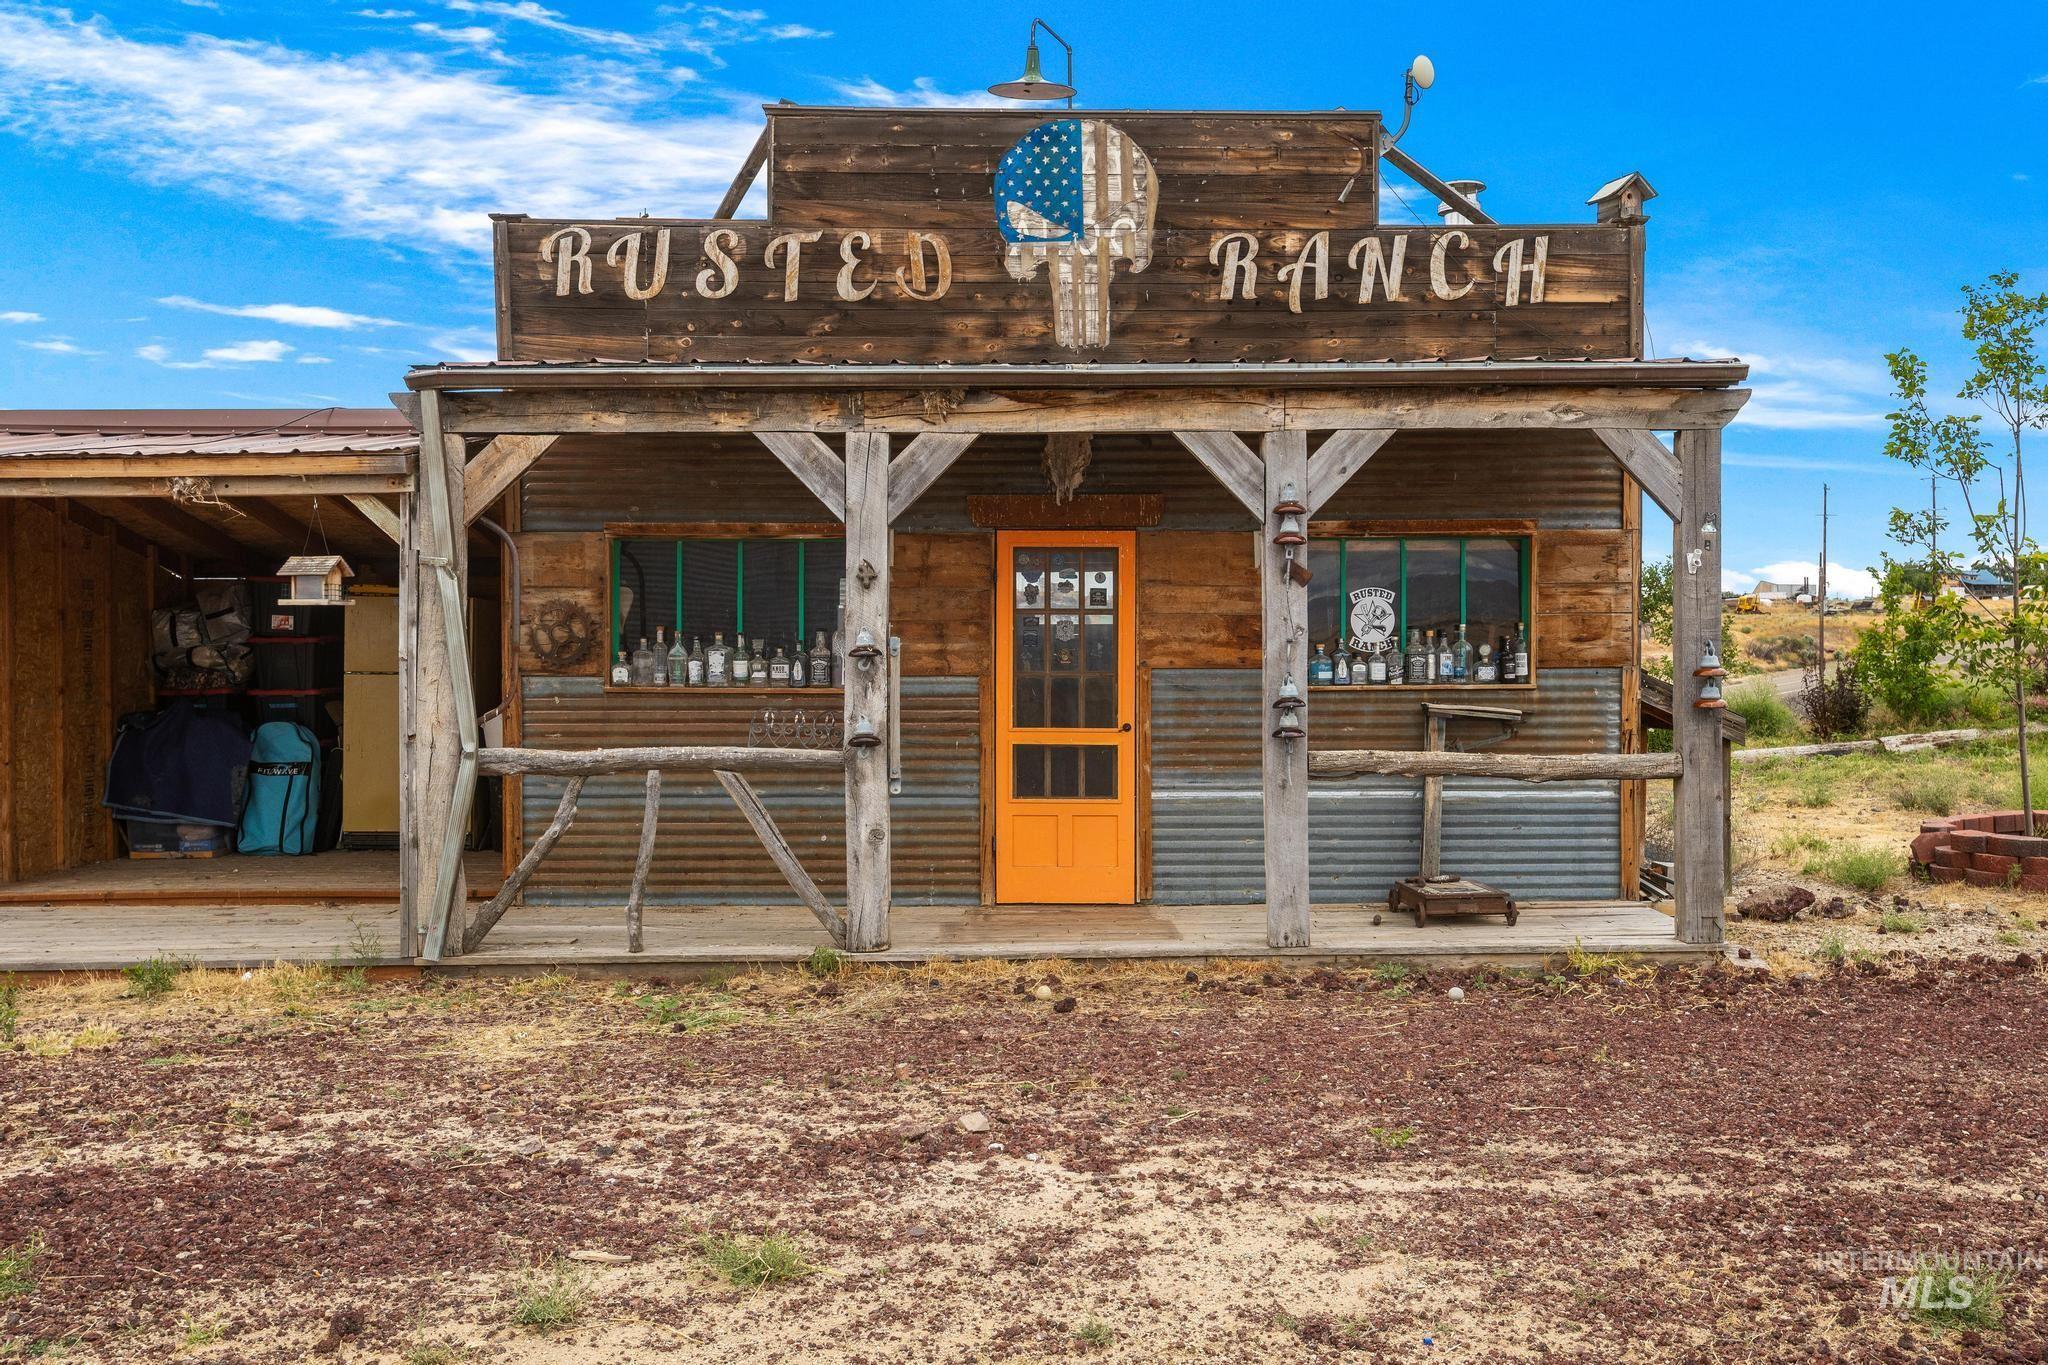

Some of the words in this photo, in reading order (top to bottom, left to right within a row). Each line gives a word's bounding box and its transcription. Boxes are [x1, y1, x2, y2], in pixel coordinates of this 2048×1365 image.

[542, 227, 953, 302] RUSTED
[1208, 230, 1549, 314] RANCH
[1353, 588, 1393, 601] RUSTED
